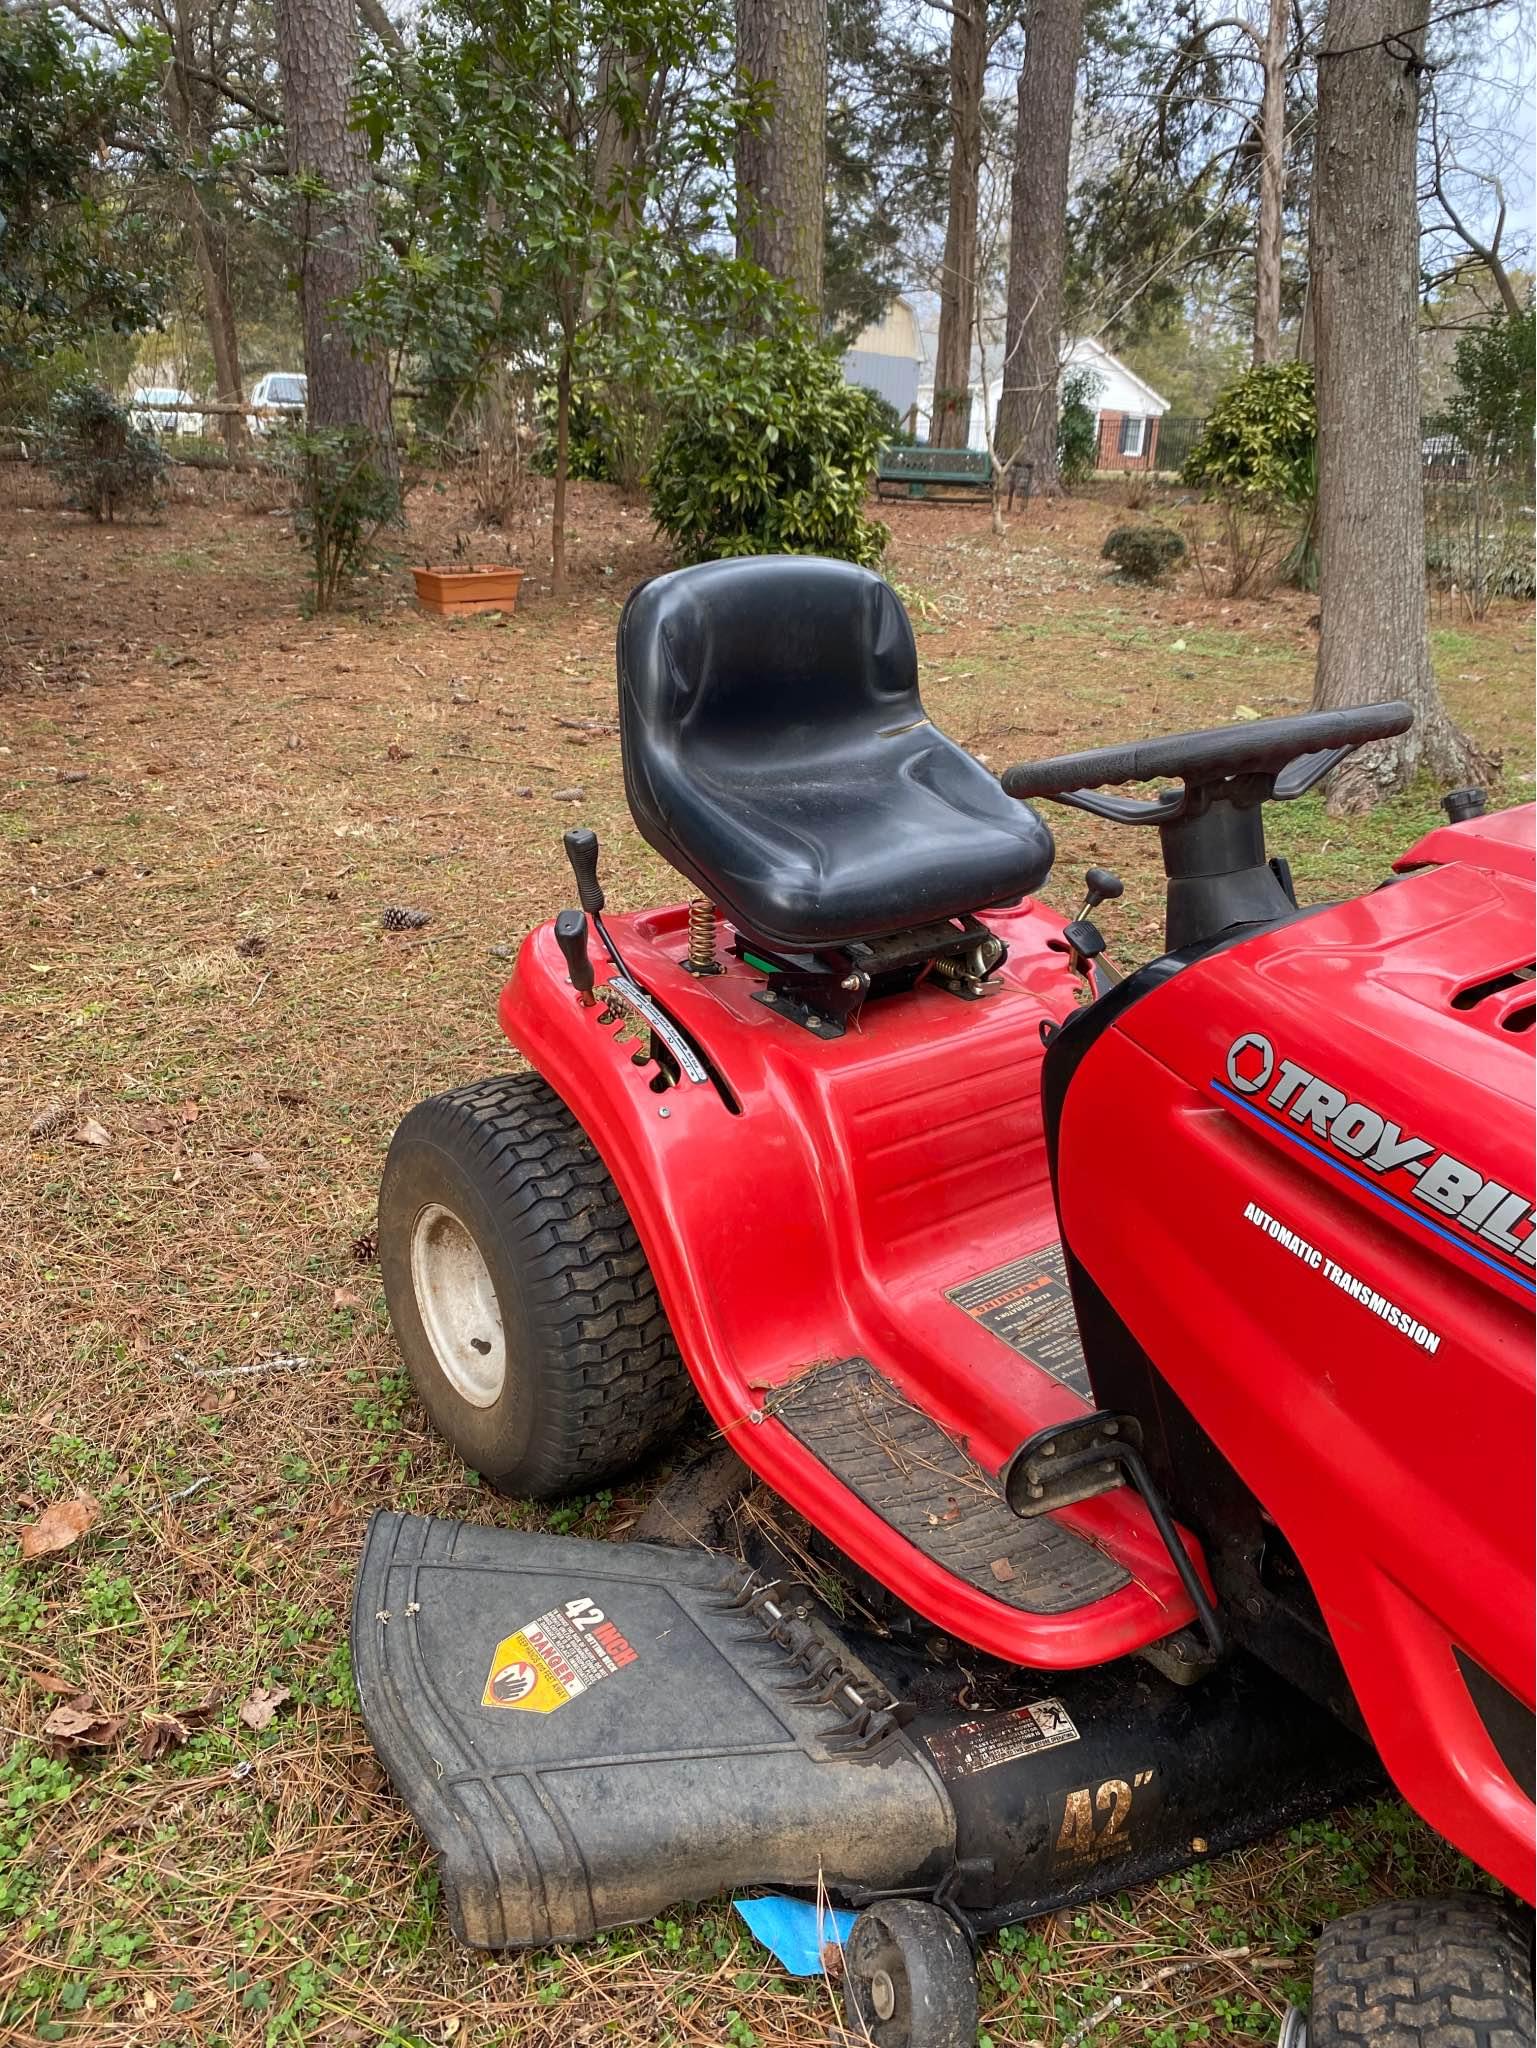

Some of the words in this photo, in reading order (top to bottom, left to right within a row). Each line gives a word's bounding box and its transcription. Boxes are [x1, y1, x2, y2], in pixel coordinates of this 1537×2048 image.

[1243, 1201, 1322, 1269] AUTOMATIC
[1322, 1257, 1441, 1354] TRANSMISSION
[529, 1632, 575, 1683] DANGER
[564, 1597, 604, 1632] 42
[592, 1622, 640, 1669] INCH
